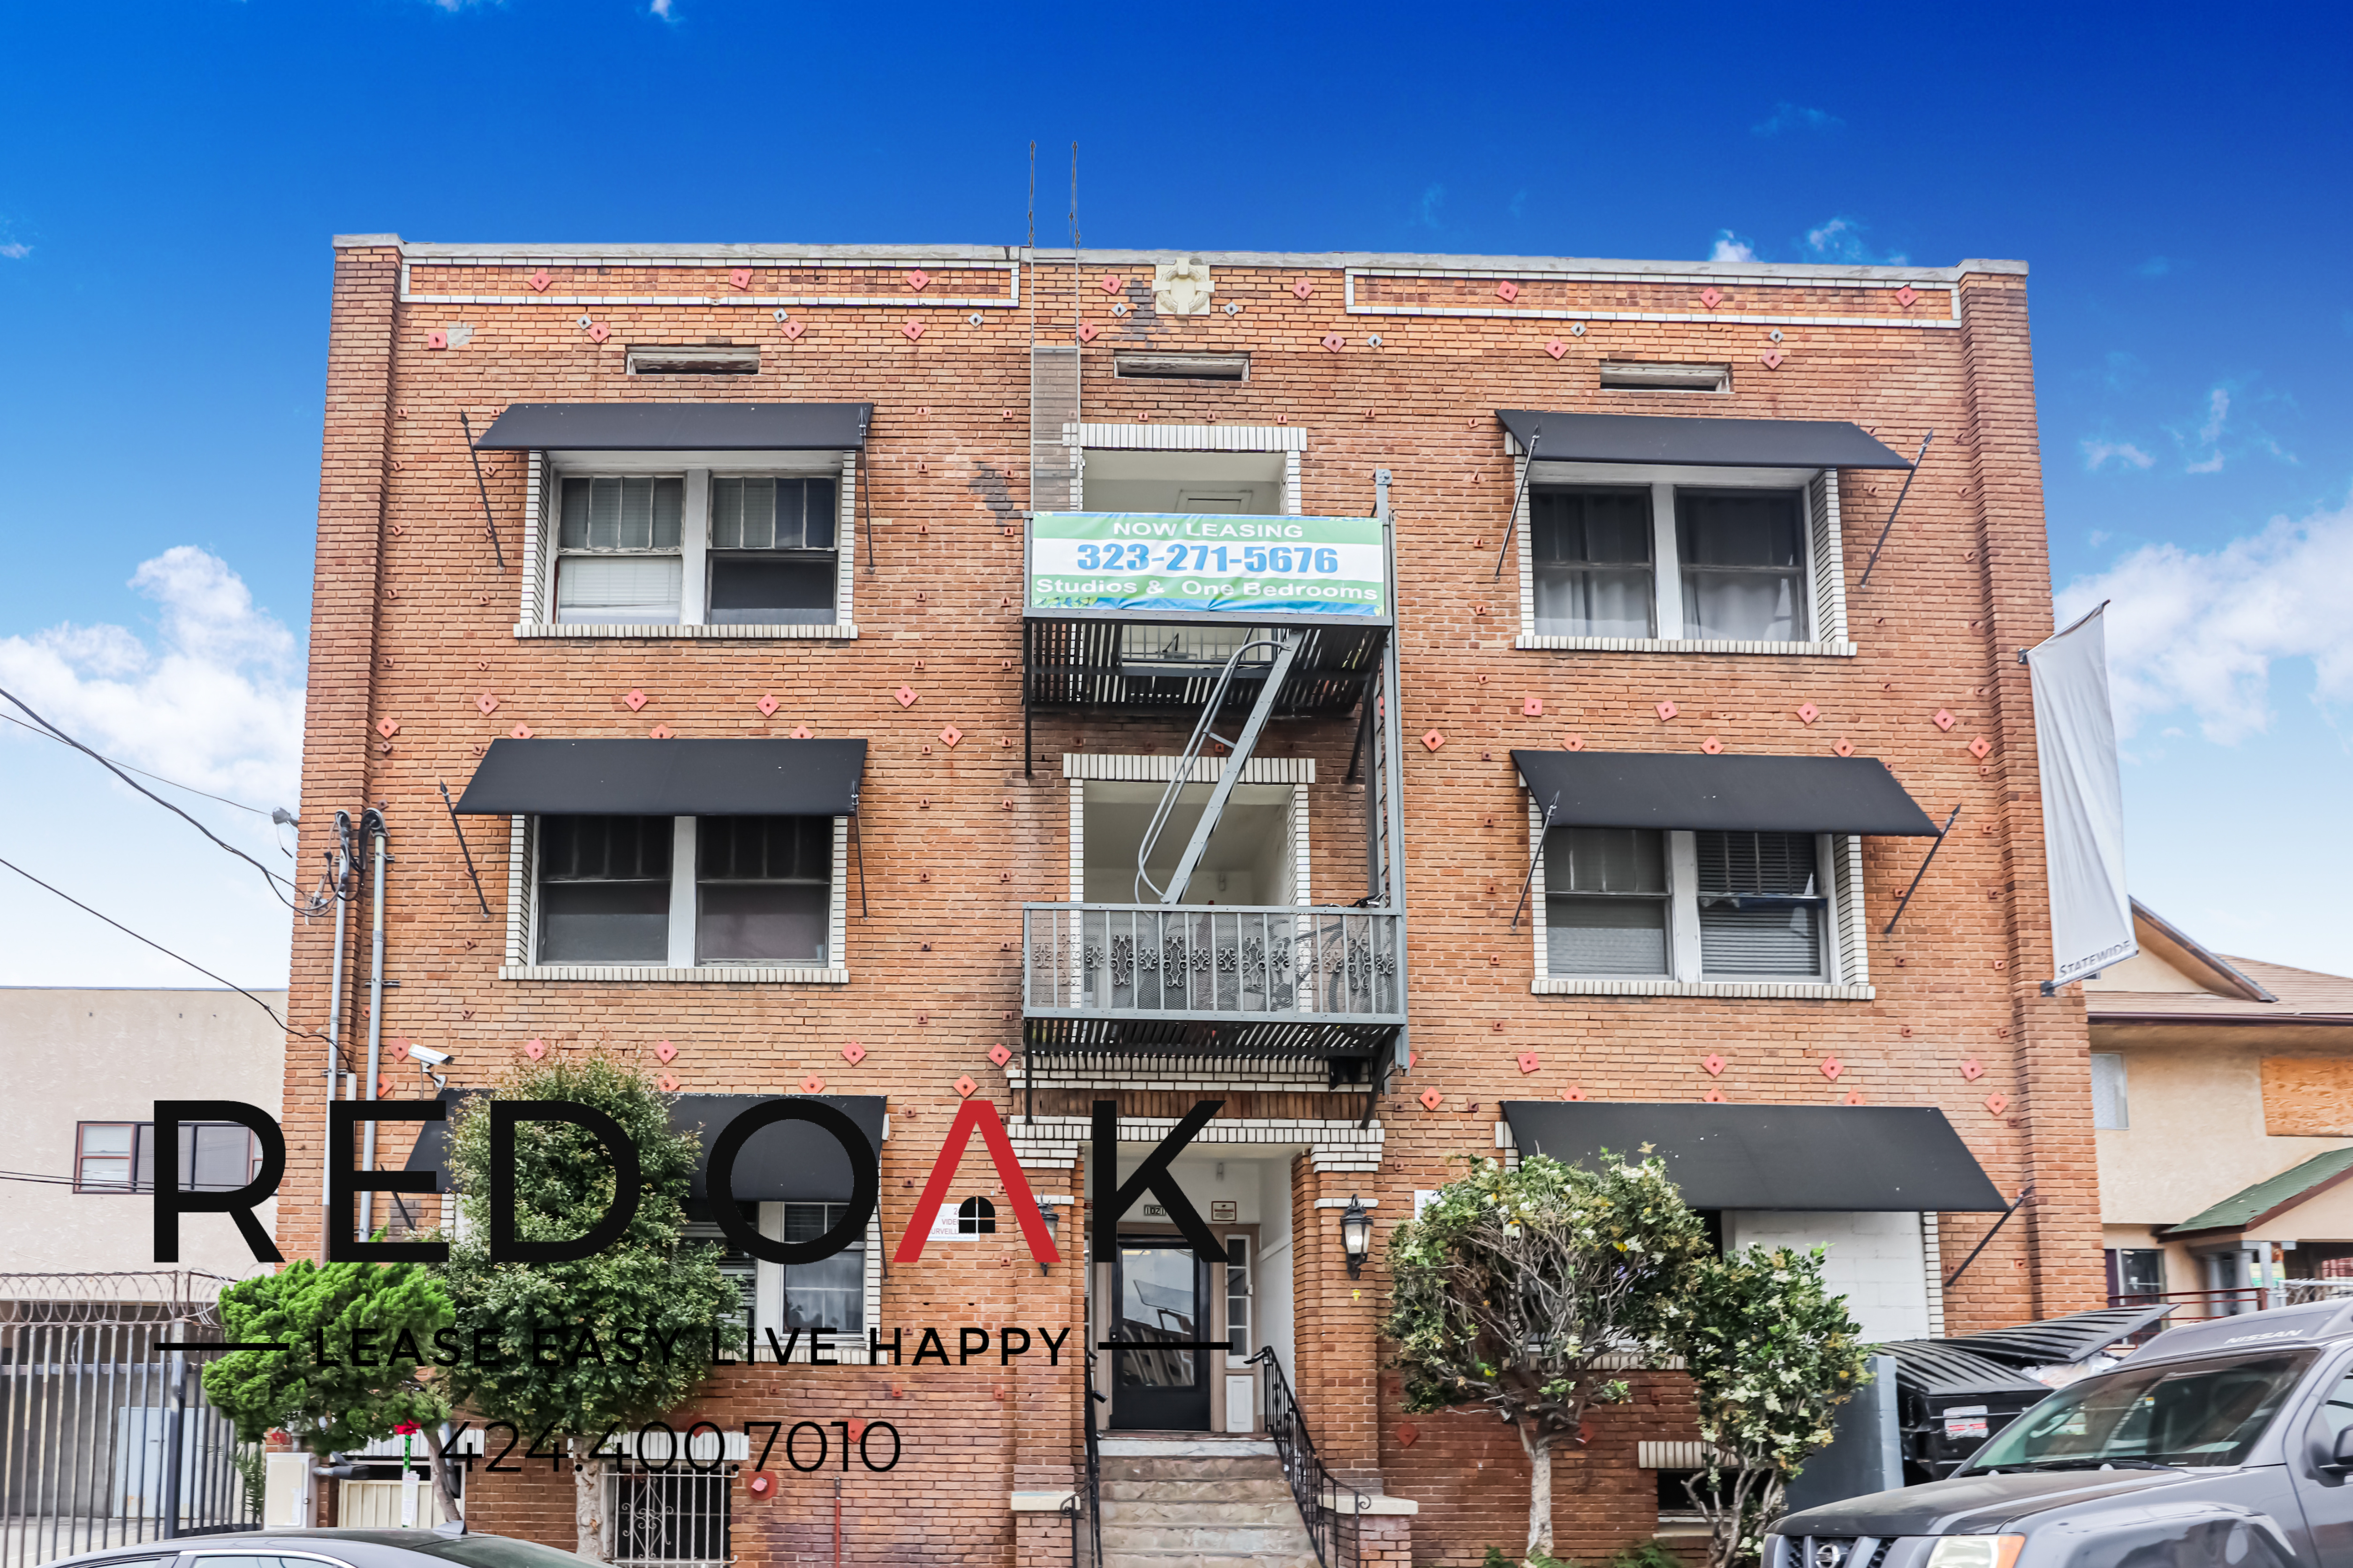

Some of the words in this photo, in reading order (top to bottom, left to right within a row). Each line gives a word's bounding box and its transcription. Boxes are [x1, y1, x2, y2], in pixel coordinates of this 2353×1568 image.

[1114, 522, 1179, 536] NOW
[1186, 523, 1303, 538] LEASING
[1077, 543, 1338, 573] 323-271-5676
[1036, 579, 1138, 594] Studios
[1145, 580, 1165, 595] &
[1181, 580, 1234, 596] One
[1243, 582, 1378, 601] Bedrooms
[2059, 940, 2131, 975] STATEWIDE
[1146, 1206, 1165, 1215] 1021
[2224, 1329, 2304, 1345] NISSAN
